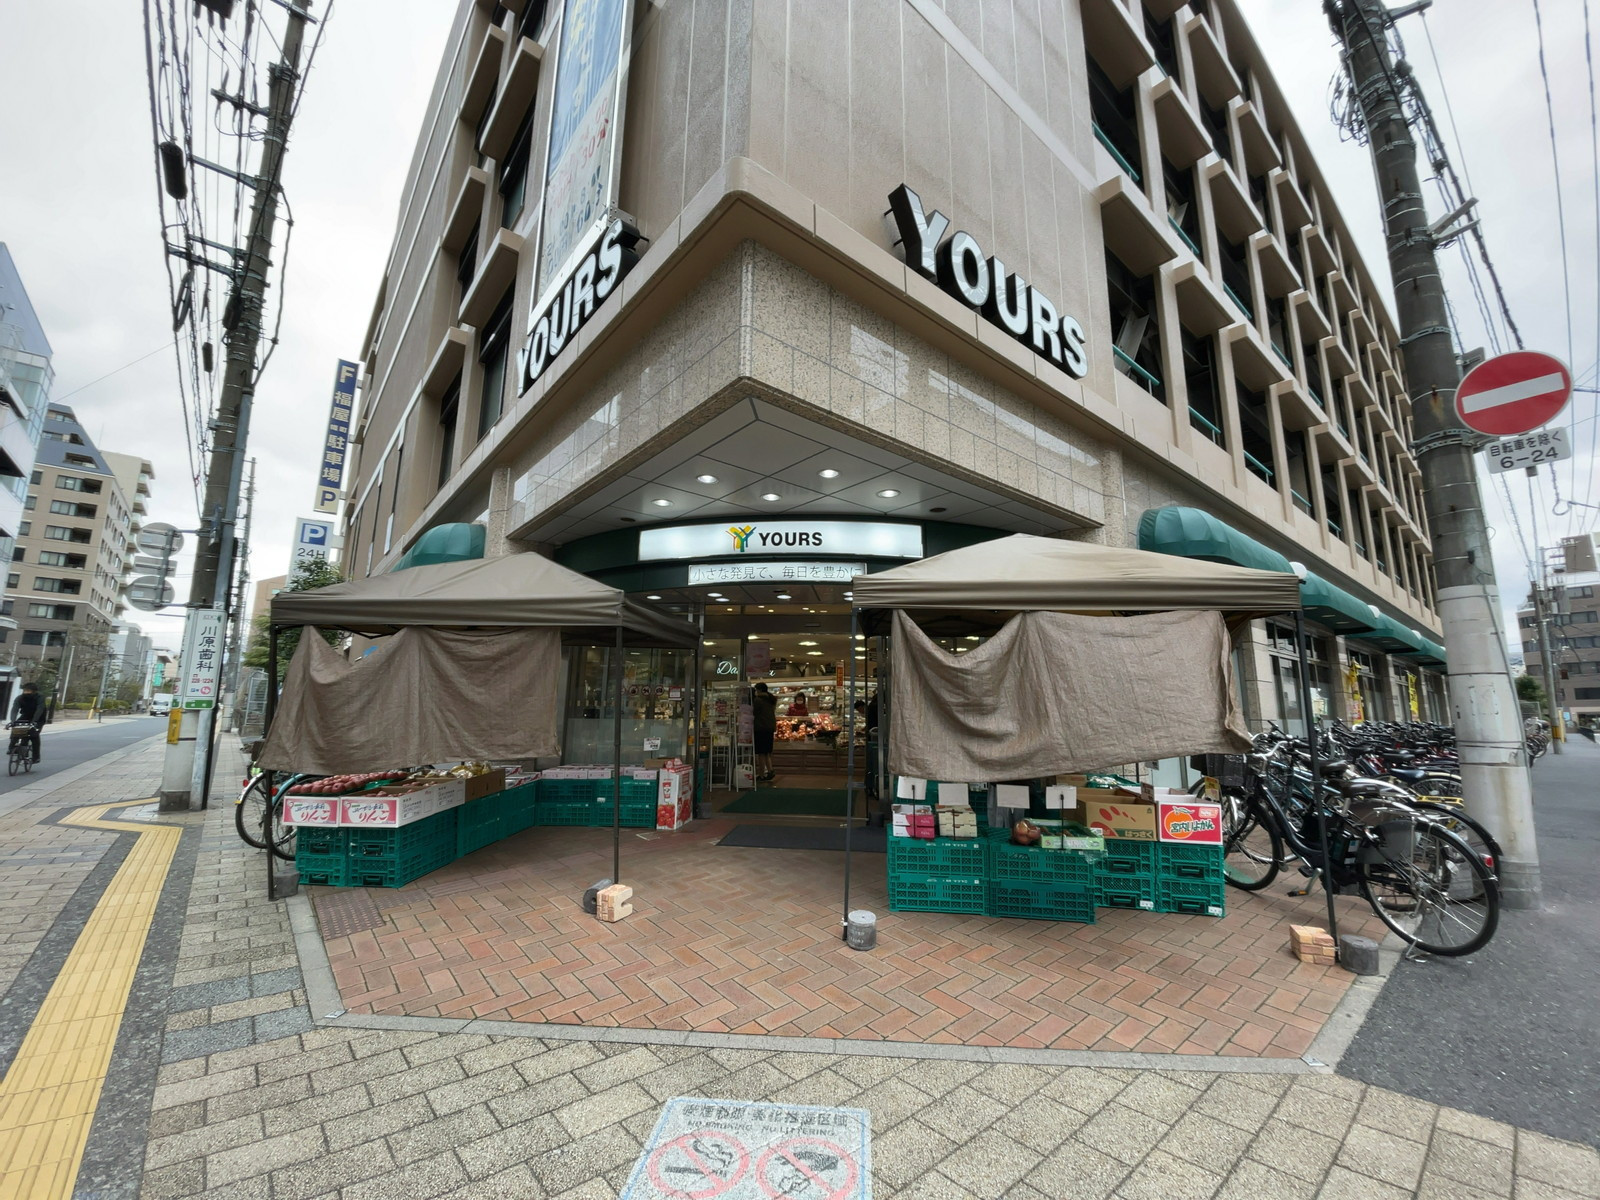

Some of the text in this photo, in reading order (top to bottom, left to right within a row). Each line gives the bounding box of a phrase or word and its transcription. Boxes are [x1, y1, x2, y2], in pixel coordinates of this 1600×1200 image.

[904, 187, 1089, 378] YOURS
[516, 218, 624, 398] YOURS
[1490, 431, 1562, 457] 自転車を除く
[1501, 447, 1558, 469] 6-24
[320, 490, 337, 507] P
[304, 524, 325, 543] P
[758, 531, 823, 547] YOURS
[297, 547, 326, 560] 24H
[197, 626, 217, 672] 川原歯科
[300, 810, 330, 822] りんご
[358, 810, 390, 822] りんご
[1124, 830, 1153, 838] はっさく
